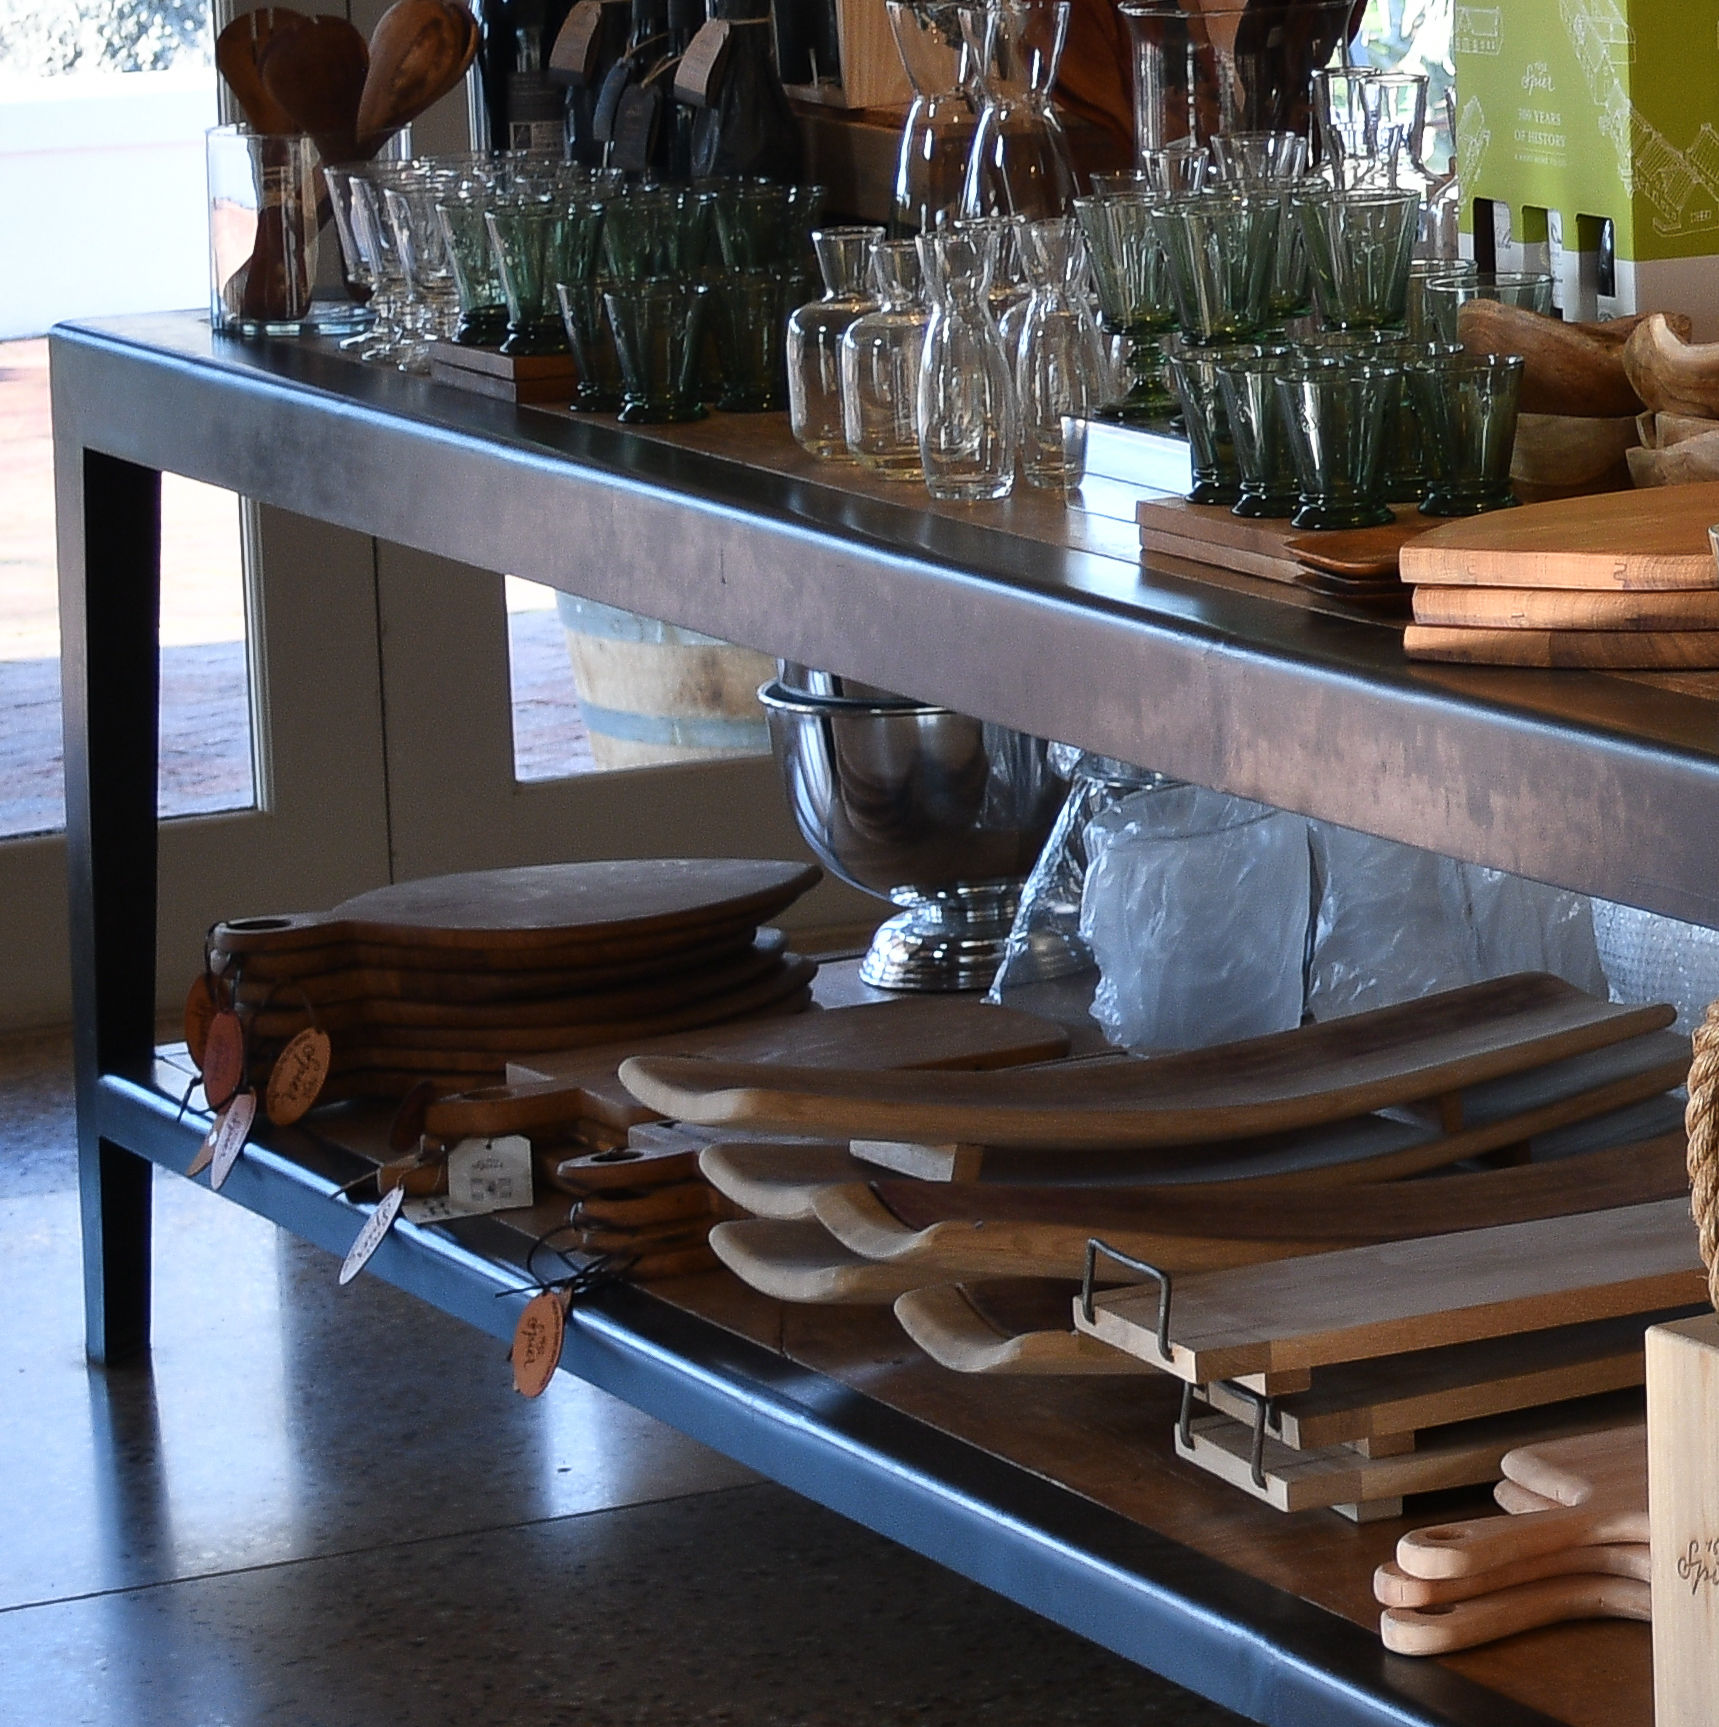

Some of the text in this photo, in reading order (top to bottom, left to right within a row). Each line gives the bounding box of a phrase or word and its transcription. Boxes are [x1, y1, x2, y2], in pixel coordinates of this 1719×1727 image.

[1521, 64, 1555, 96] Spier
[1534, 110, 1561, 126] YEARS
[1514, 129, 1566, 148] OF HISTORY
